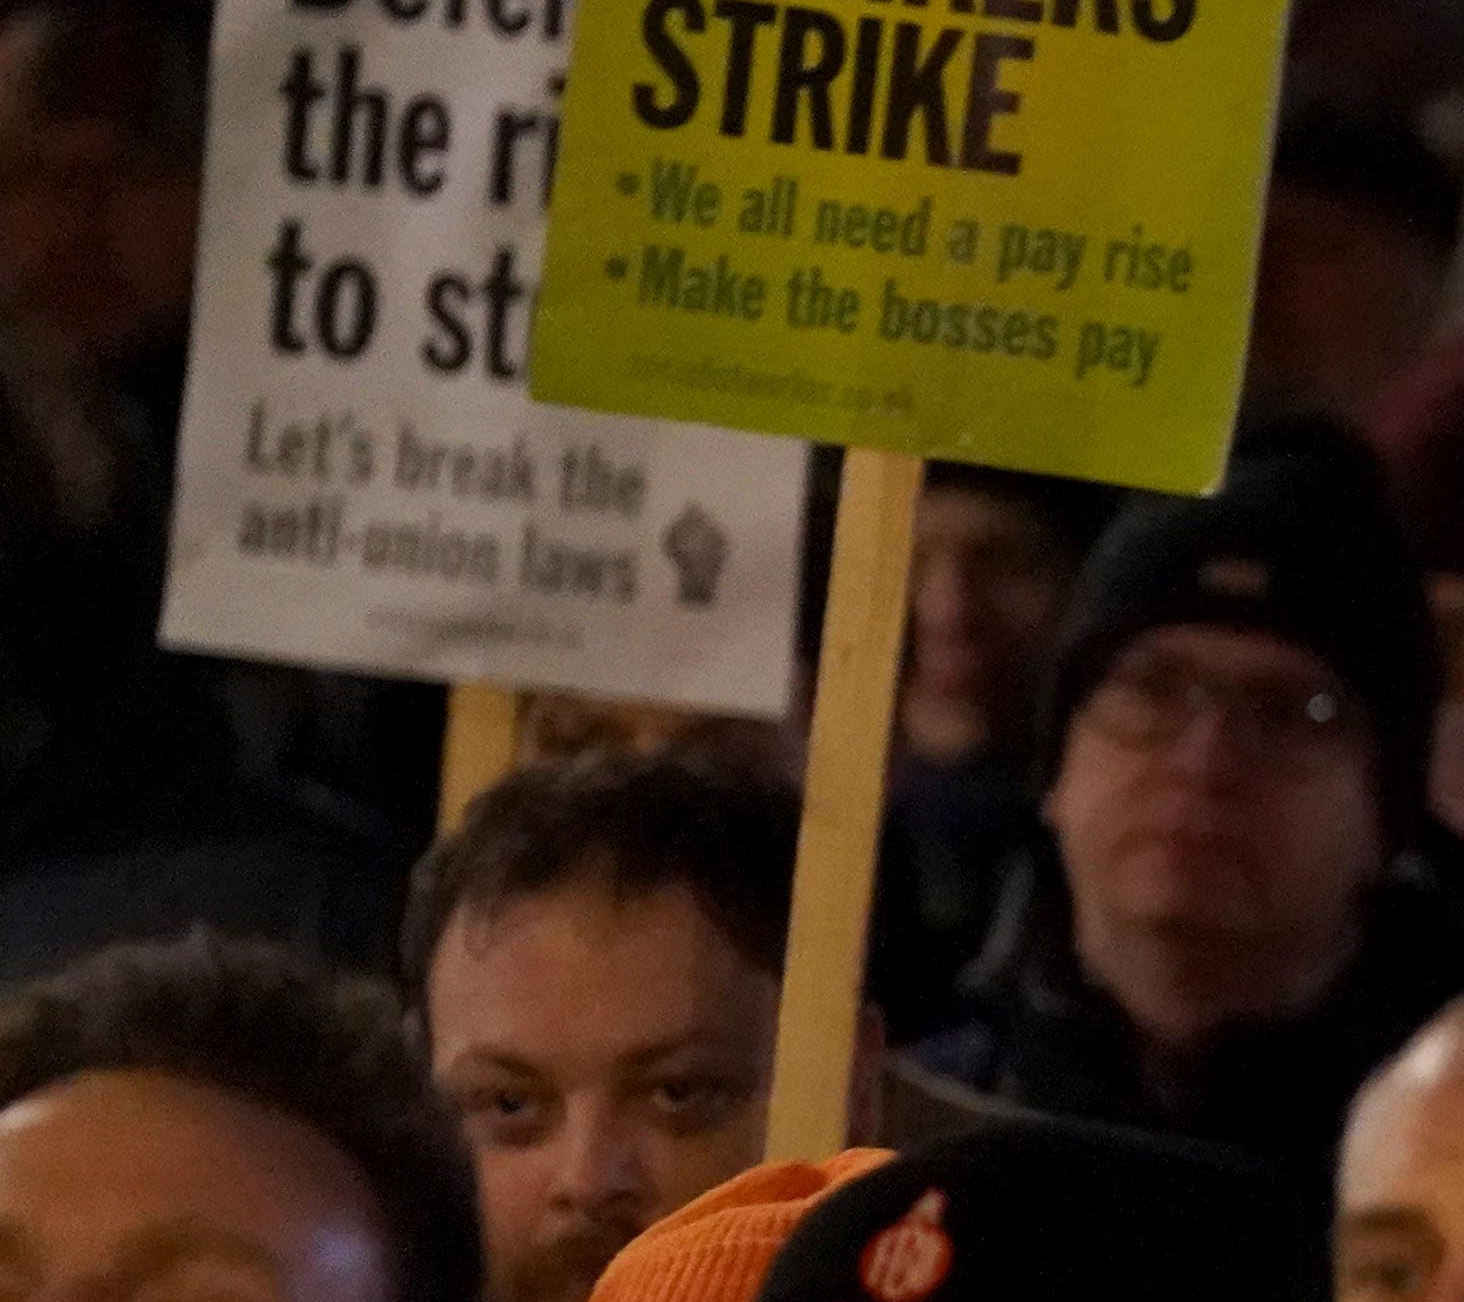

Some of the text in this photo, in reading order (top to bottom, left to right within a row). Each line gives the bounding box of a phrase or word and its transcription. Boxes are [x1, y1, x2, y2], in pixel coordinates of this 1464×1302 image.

[279, 43, 450, 194] the
[266, 216, 379, 362] to
[648, 159, 1195, 293] We all need a pay rise
[637, 245, 1160, 390] Make the bosses pay
[396, 417, 535, 500] break
